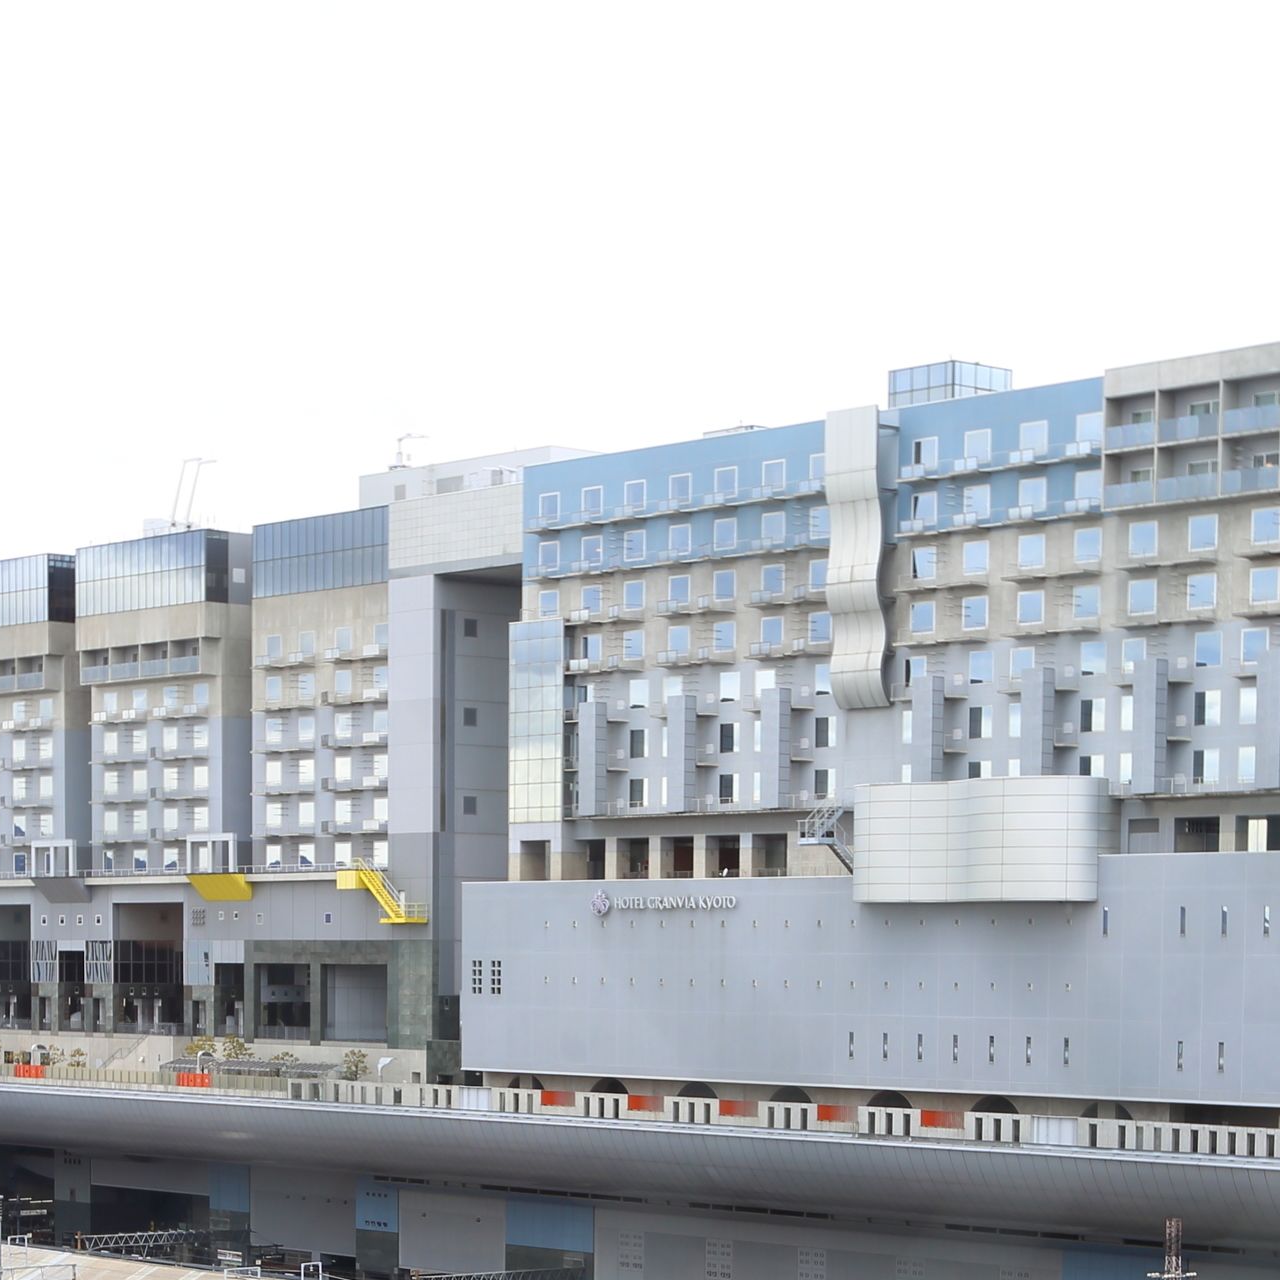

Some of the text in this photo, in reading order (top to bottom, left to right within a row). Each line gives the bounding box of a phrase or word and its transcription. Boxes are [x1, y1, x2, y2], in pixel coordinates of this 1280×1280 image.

[614, 895, 737, 911] HOTEL GRANVIA KYOTO
